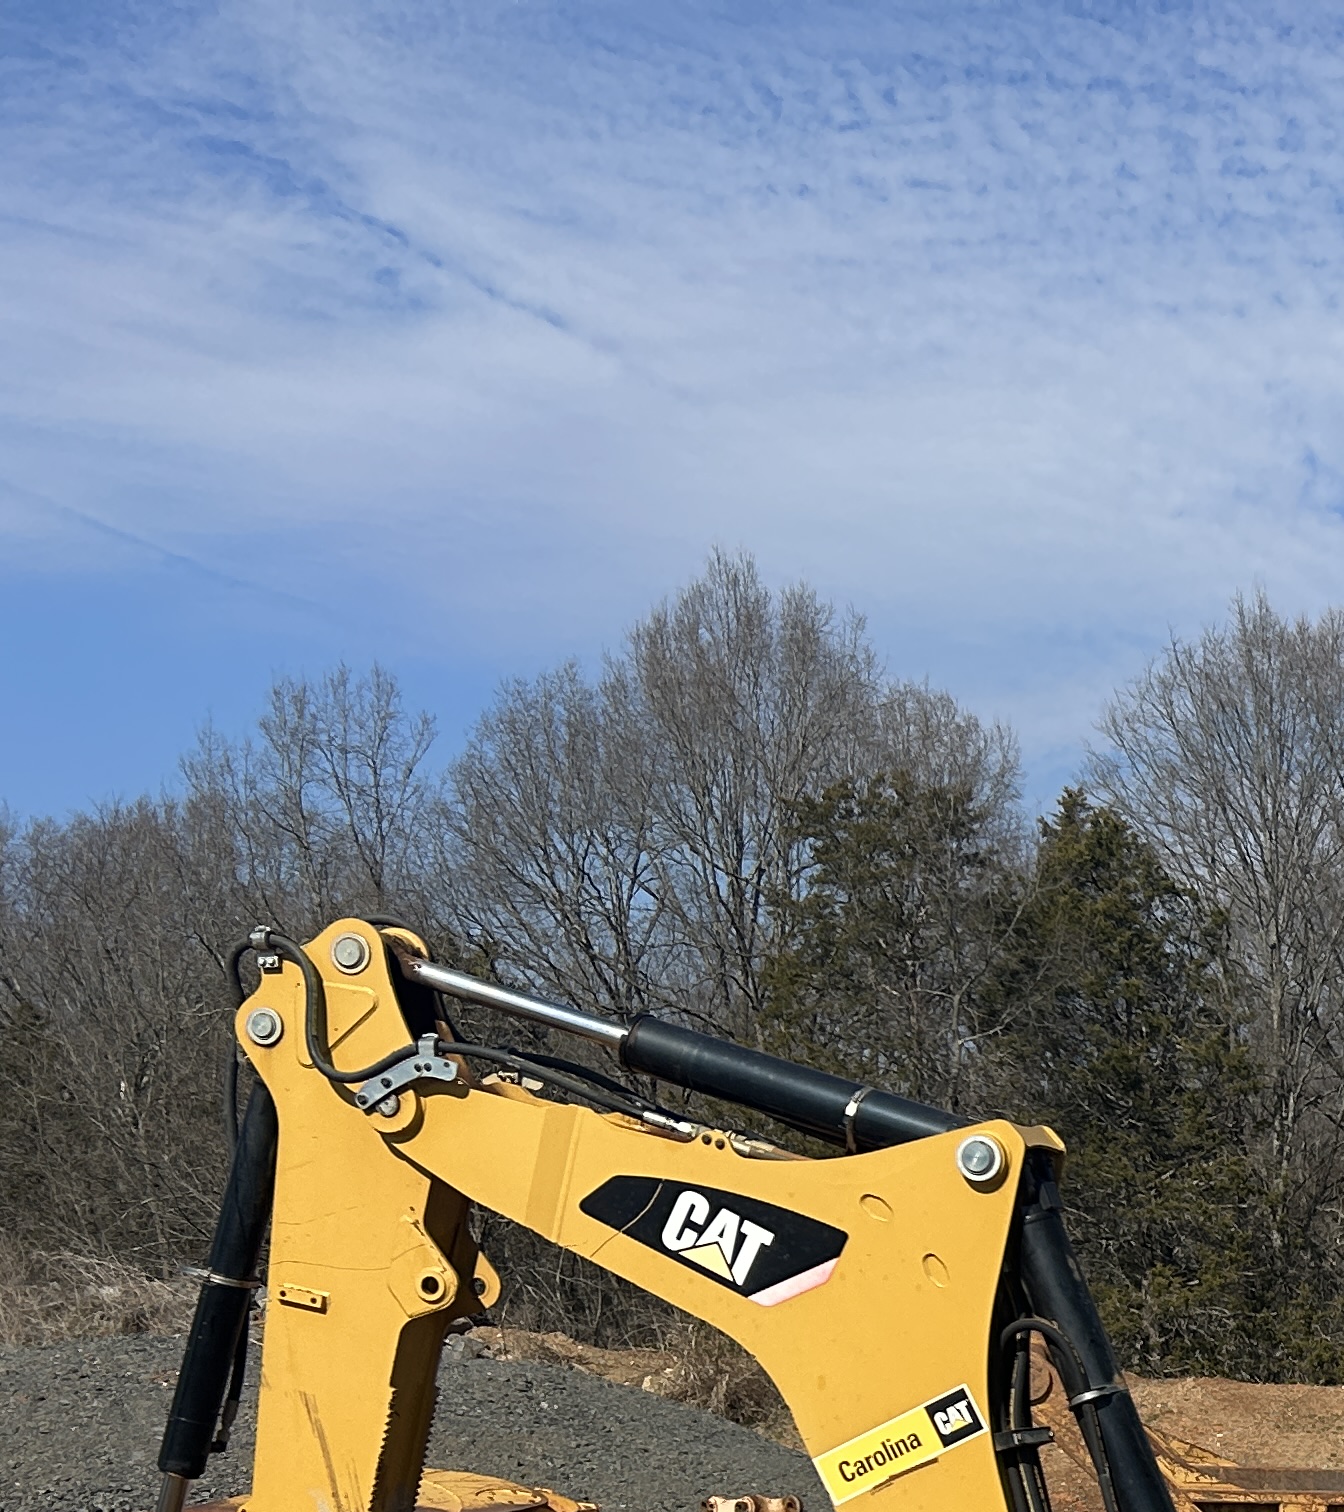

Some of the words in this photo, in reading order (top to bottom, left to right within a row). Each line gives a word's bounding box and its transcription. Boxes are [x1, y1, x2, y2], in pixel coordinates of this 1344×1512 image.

[661, 1189, 776, 1287] CAT
[837, 1431, 923, 1483] Carolina
[932, 1398, 974, 1436] CAT
